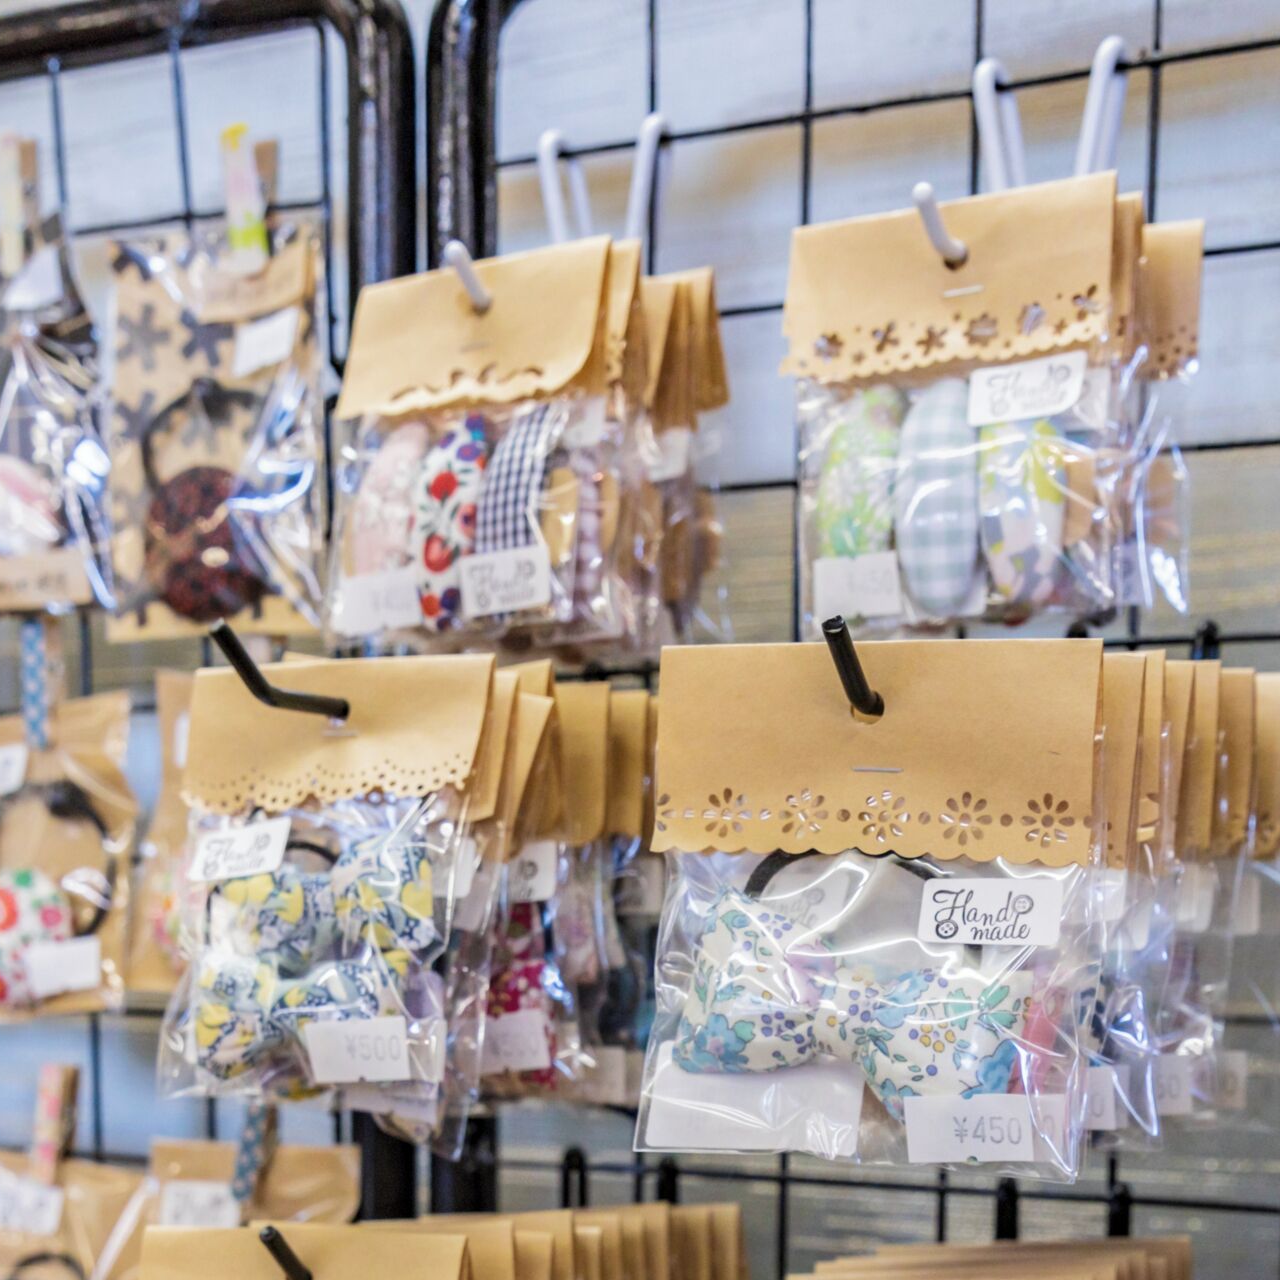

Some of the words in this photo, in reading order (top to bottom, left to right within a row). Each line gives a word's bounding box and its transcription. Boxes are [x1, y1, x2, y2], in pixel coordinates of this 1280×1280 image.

[932, 889, 1012, 927] Hand
[970, 914, 1031, 941] made
[953, 1115, 1022, 1146] ¥450
